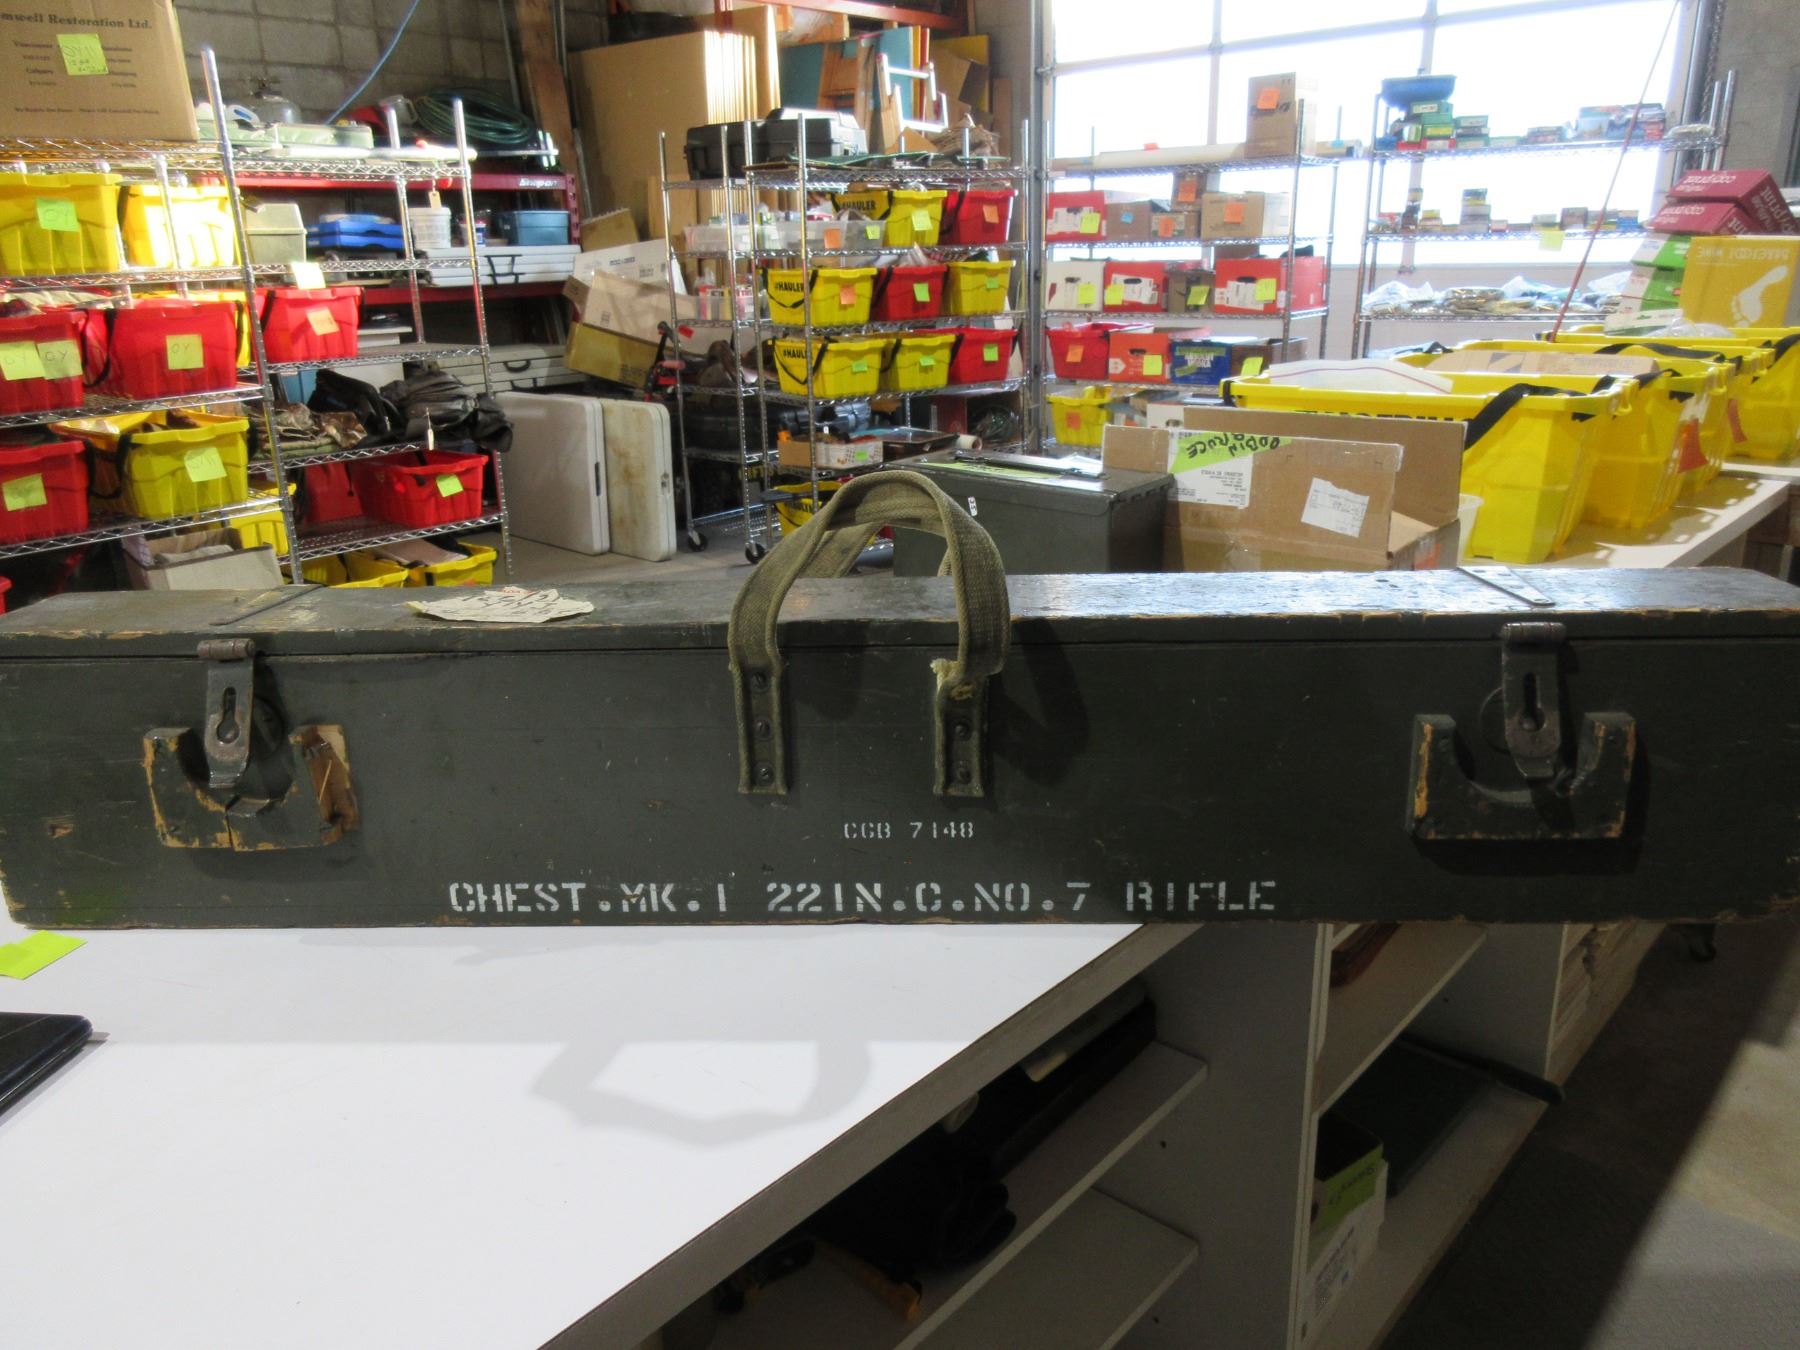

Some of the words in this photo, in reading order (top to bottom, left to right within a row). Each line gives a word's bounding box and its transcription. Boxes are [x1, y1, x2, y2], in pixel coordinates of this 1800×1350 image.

[48, 14, 124, 28] Restoration
[128, 18, 152, 30] Ltd.
[909, 821, 974, 839] 7148
[1126, 880, 1276, 911] RIFLE
